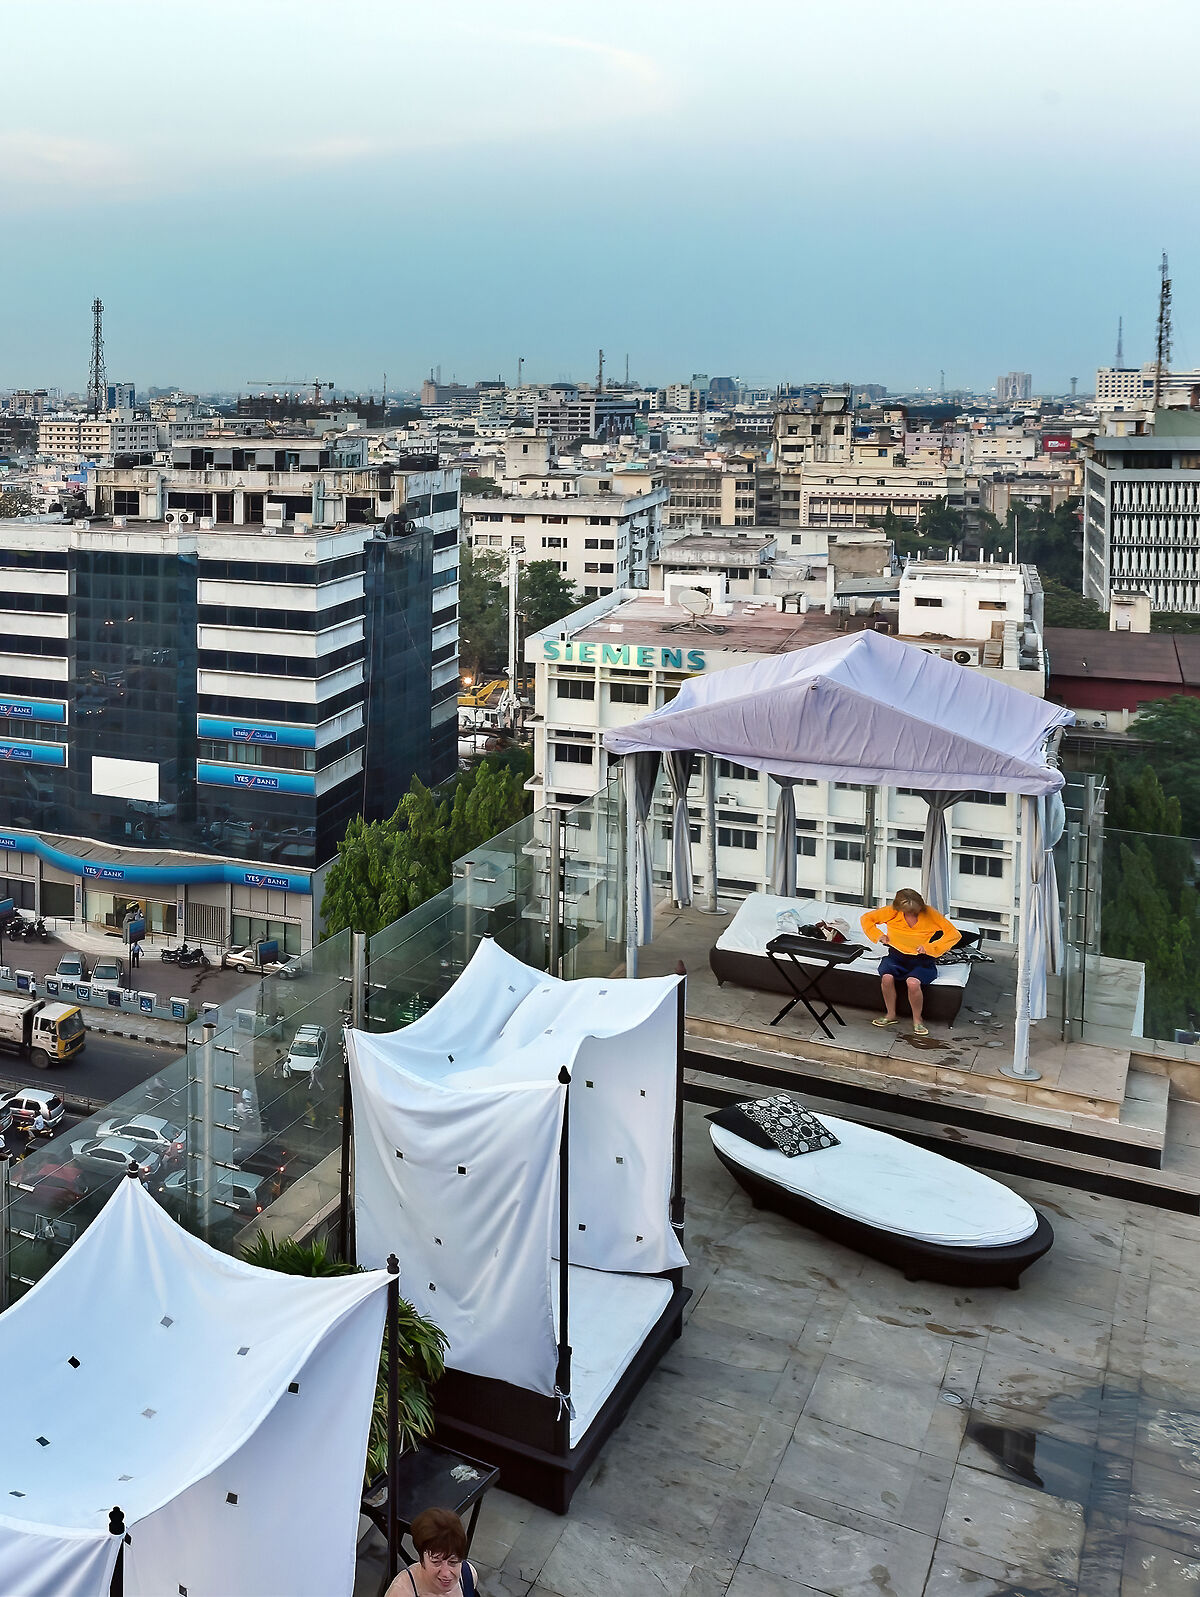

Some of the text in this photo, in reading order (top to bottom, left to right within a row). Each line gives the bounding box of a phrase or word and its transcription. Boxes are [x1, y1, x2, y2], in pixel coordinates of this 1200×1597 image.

[543, 640, 707, 671] SIEMENS
[13, 706, 31, 714] BANK
[236, 775, 276, 786] YES BANK
[85, 866, 97, 875] YES
[246, 874, 287, 886] YES BANK
